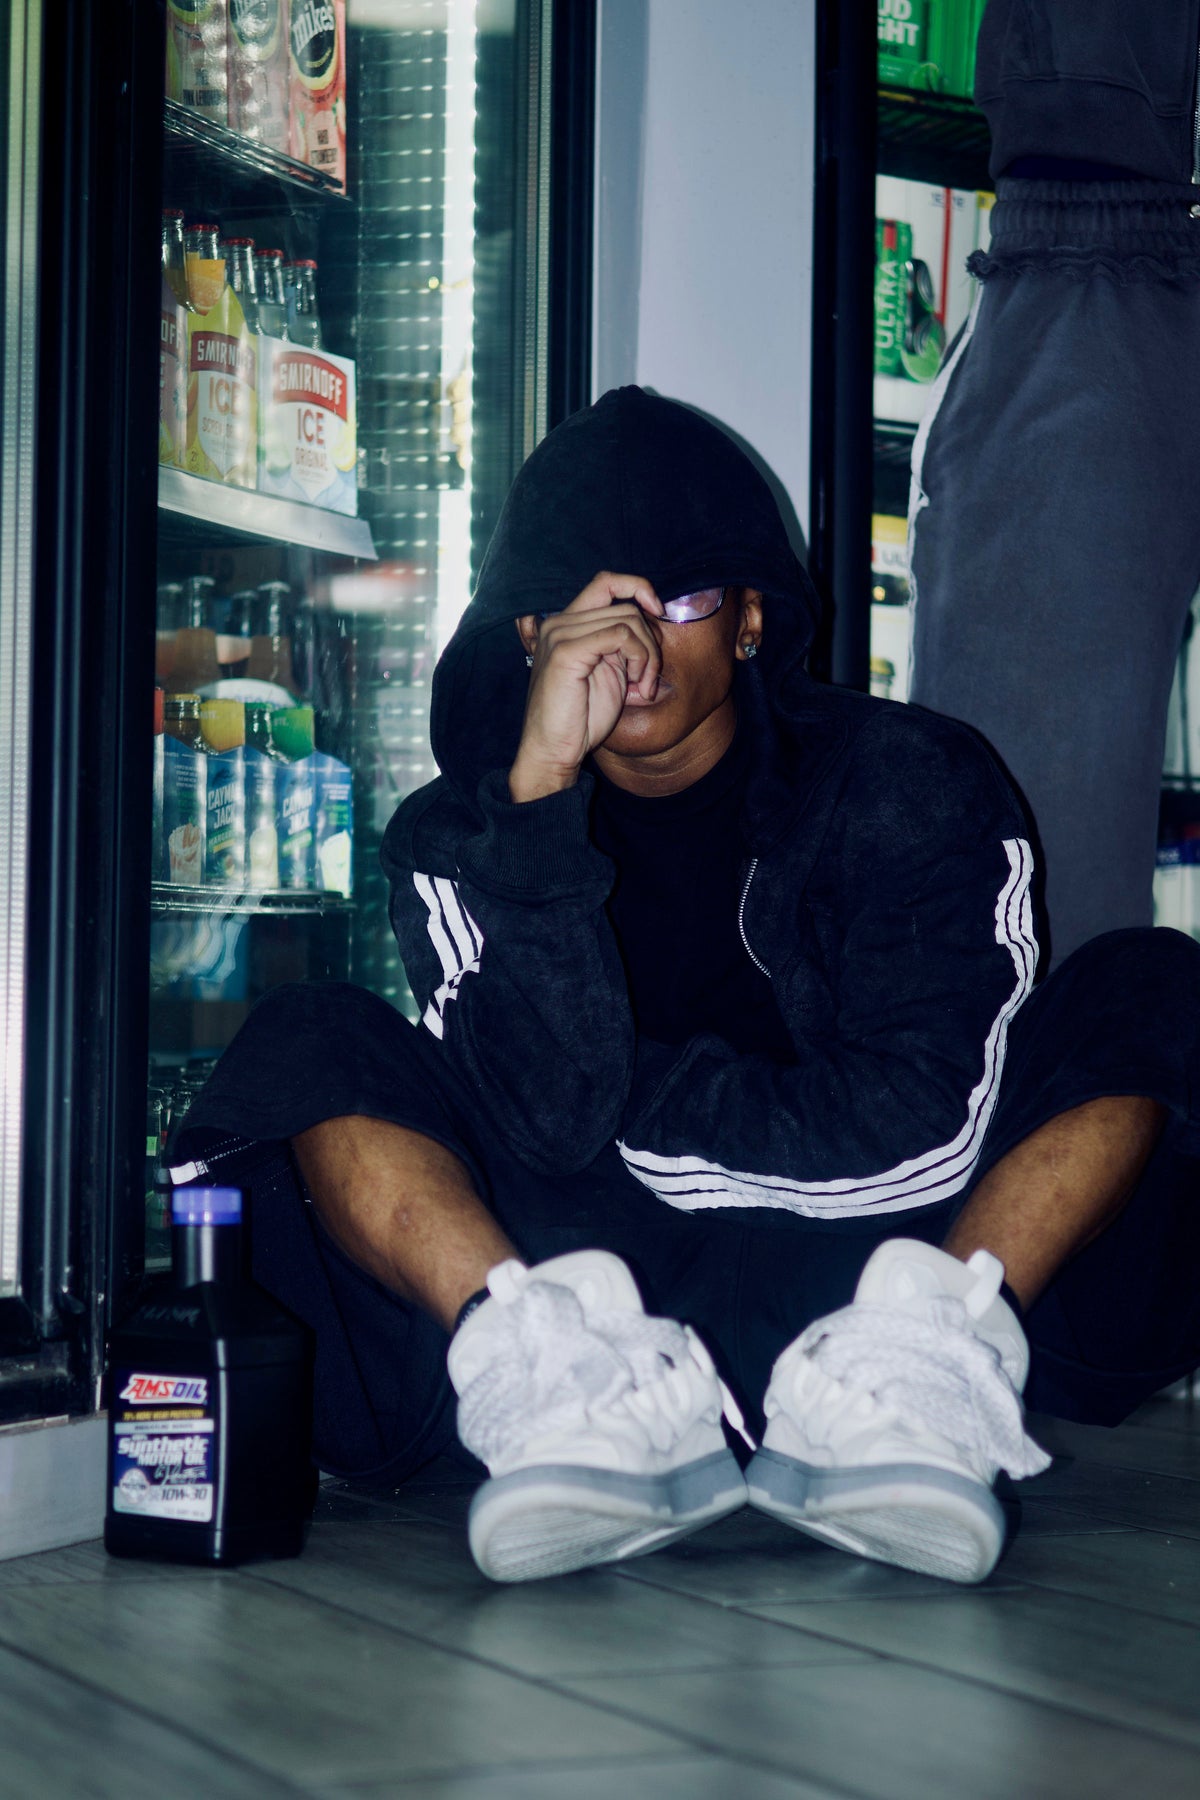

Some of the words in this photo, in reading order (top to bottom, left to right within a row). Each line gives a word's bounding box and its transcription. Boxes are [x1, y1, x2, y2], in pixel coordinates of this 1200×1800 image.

[878, 0, 912, 20] UD
[875, 259, 899, 349] ULTRA
[279, 362, 343, 405] SMIRNOFF
[297, 408, 325, 445] ICE
[126, 1377, 205, 1401] AMSOIL
[117, 1434, 209, 1458] Synthetic
[138, 1451, 183, 1466] MOTOR
[184, 1450, 207, 1465] OIL
[160, 1487, 207, 1502] 10W-30
